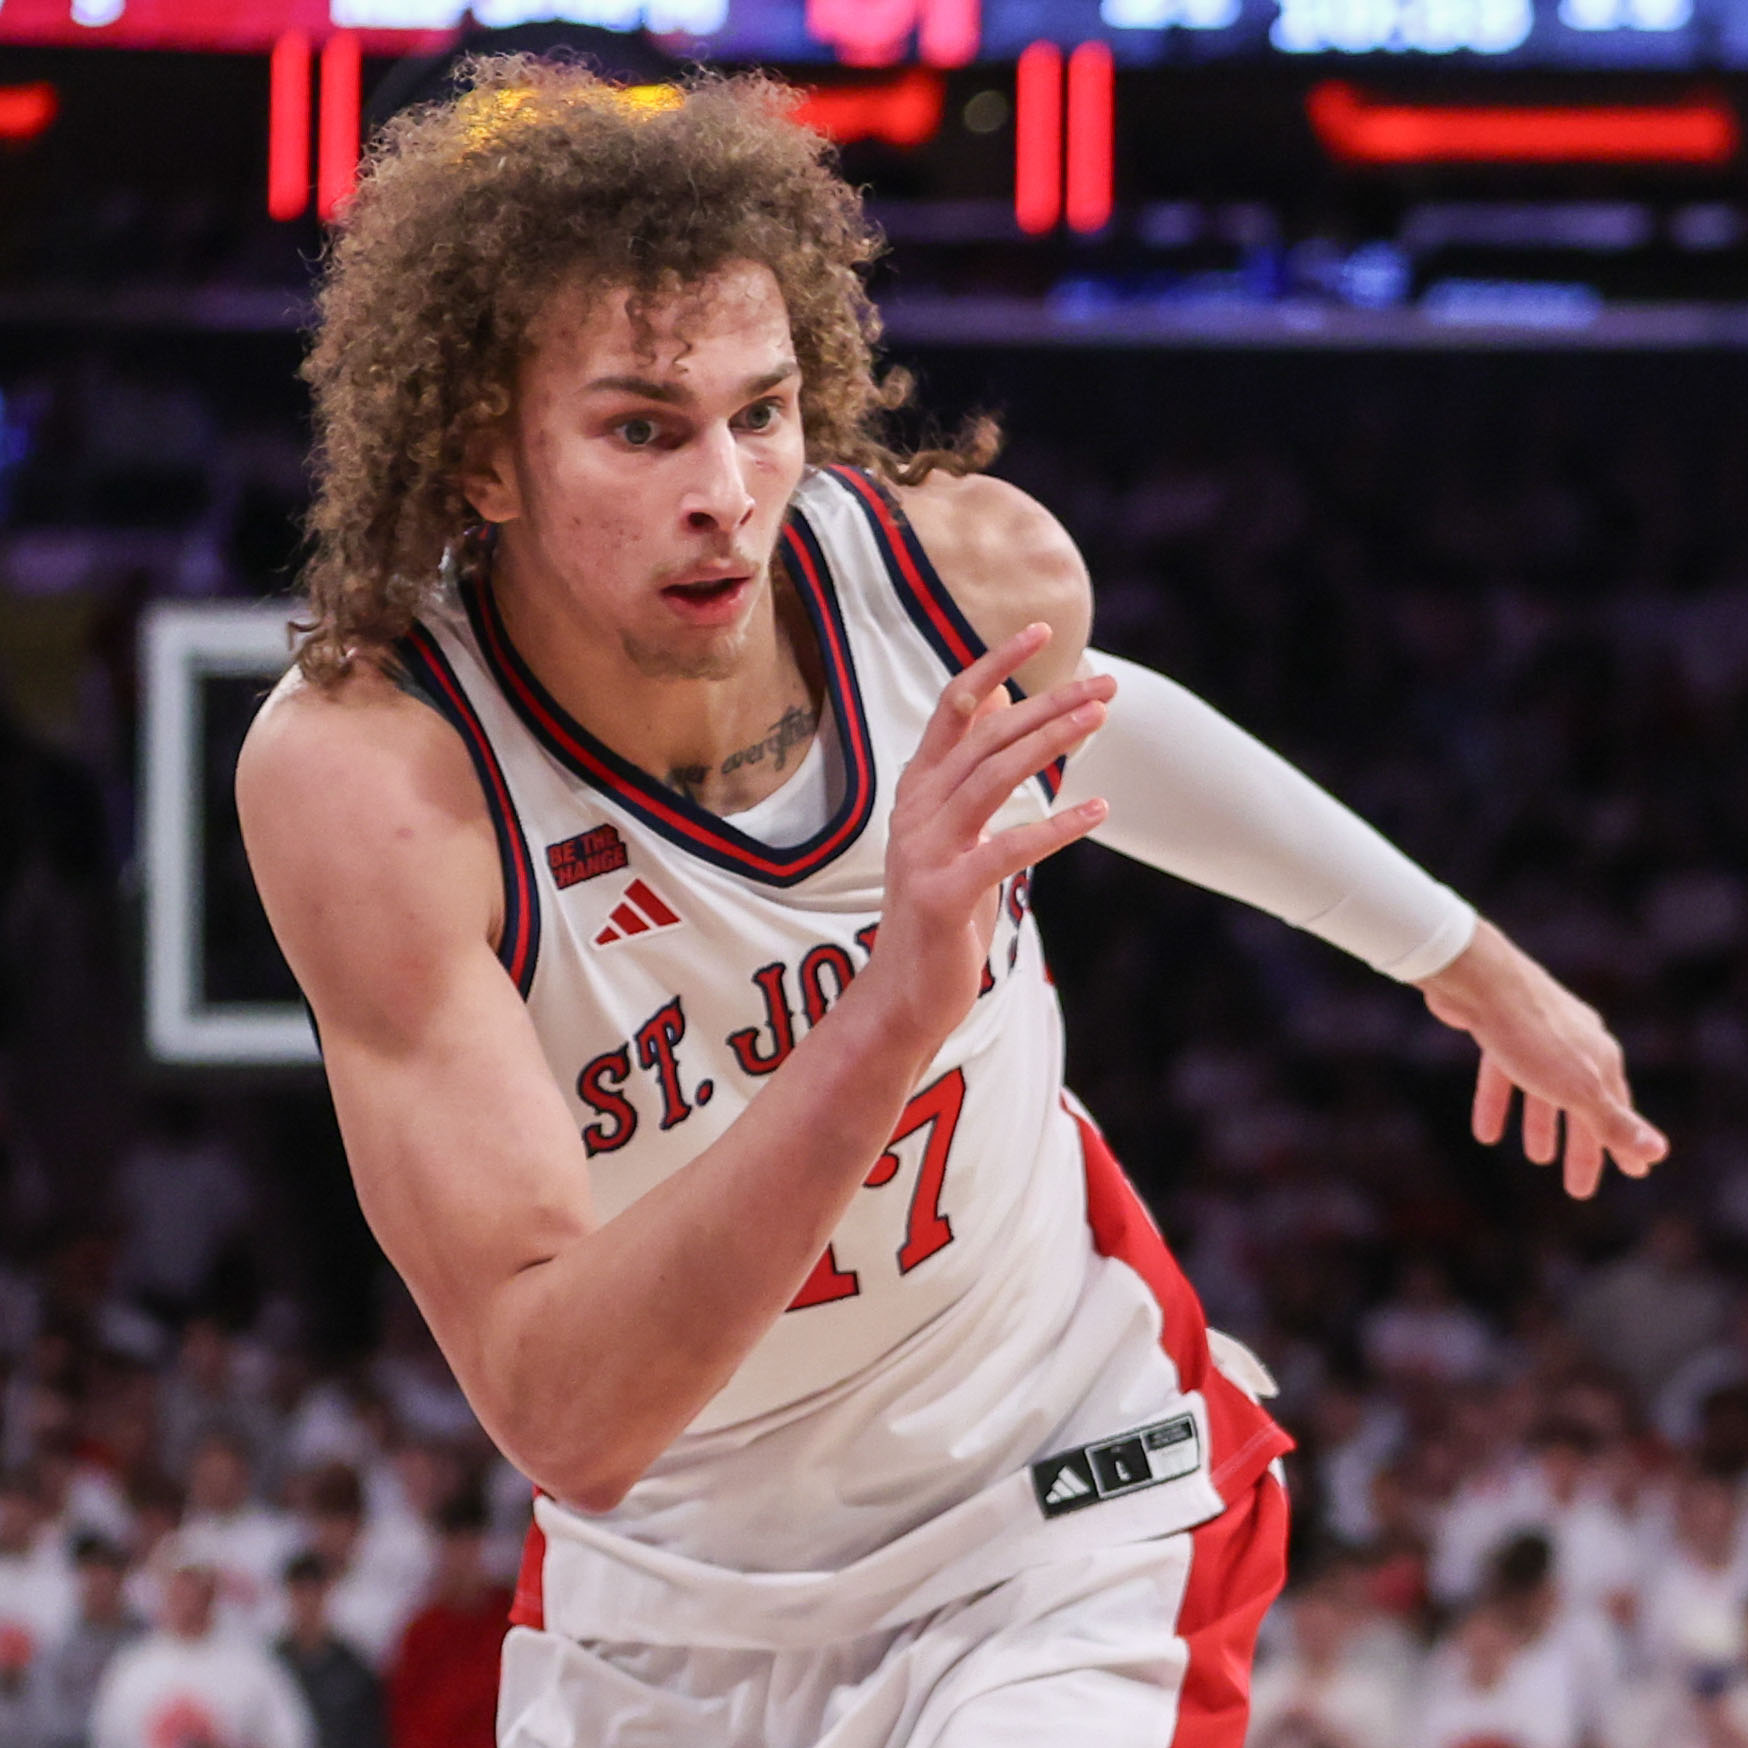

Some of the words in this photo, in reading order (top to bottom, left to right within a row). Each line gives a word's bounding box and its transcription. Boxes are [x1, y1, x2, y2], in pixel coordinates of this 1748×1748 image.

[548, 841, 577, 869] BE
[581, 824, 619, 857] THE
[552, 842, 628, 889] CHANGE
[577, 995, 714, 1159] ST.
[783, 1067, 967, 1312] 7
